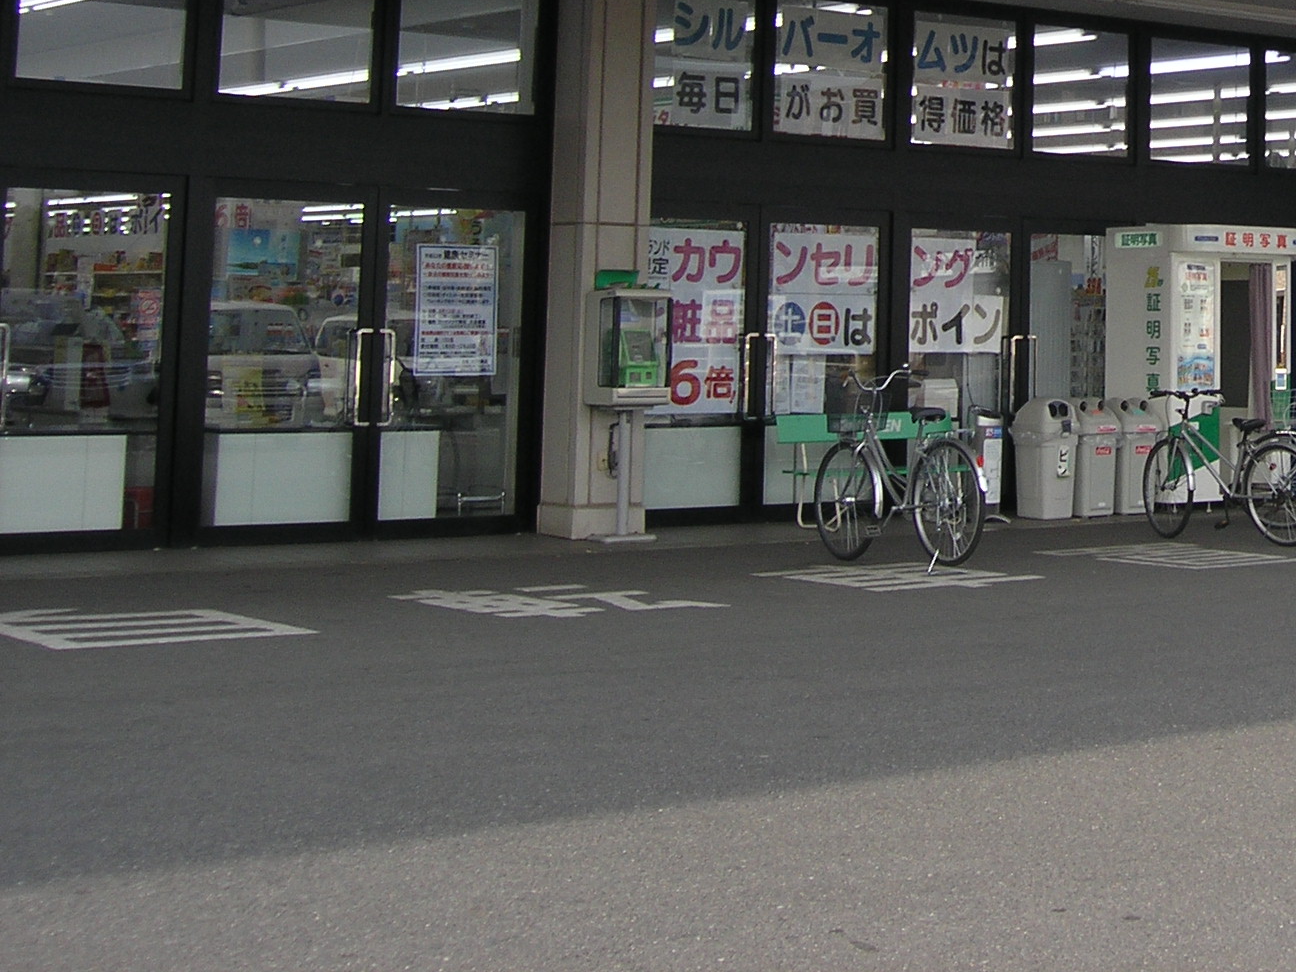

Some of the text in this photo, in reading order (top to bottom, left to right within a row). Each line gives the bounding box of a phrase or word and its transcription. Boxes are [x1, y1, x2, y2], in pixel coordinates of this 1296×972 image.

[673, 1, 1006, 78] シルバーオムツは
[676, 71, 1005, 138] 毎日がお買得価格
[1121, 233, 1157, 245] 証明写真
[1225, 232, 1288, 249] 証明写真
[649, 257, 669, 275] 定
[672, 238, 974, 288] カウンセリング
[1146, 293, 1161, 392] 証明写真
[669, 359, 736, 404] 6倍!
